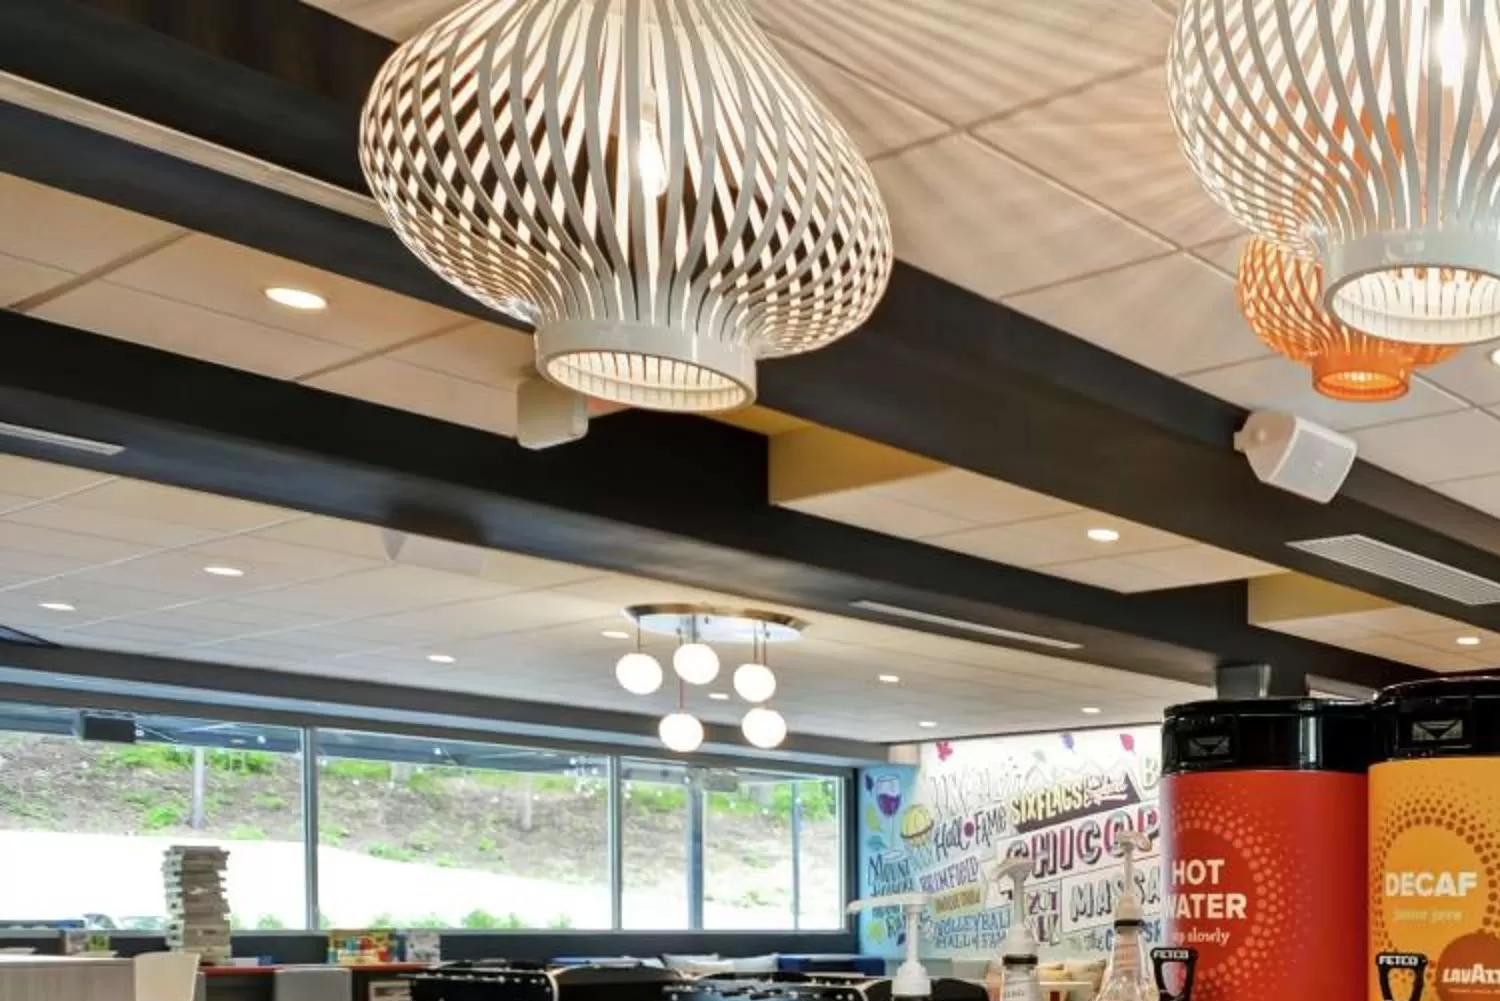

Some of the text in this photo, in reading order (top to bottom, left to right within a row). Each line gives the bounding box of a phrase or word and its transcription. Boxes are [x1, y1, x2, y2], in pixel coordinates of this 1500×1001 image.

[1171, 859, 1225, 886] HOT
[1385, 871, 1477, 897] DECAF
[1187, 926, 1231, 947] slowly
